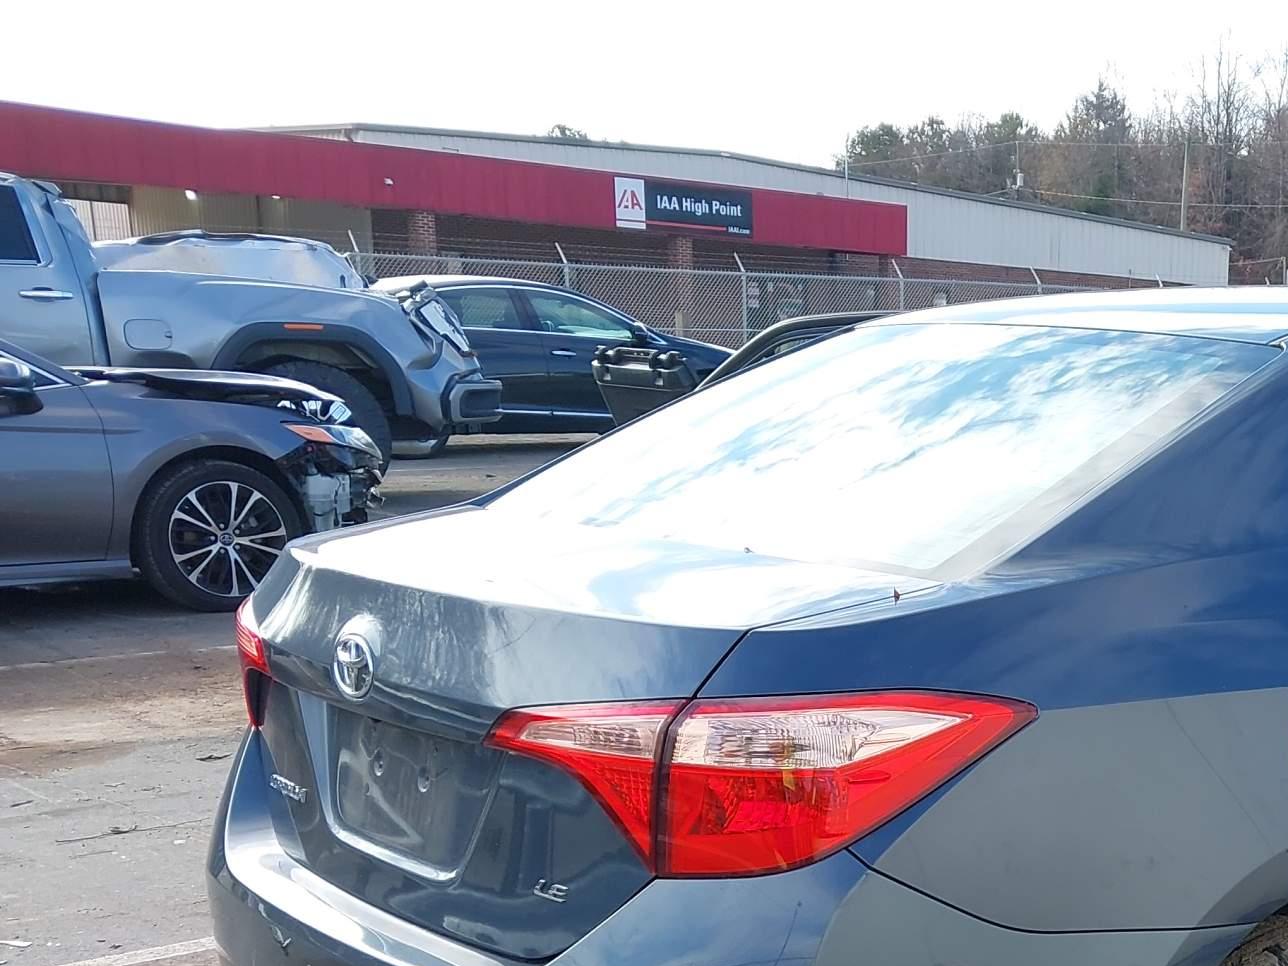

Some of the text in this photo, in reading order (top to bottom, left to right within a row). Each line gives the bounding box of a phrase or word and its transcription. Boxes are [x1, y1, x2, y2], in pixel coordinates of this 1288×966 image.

[656, 194, 742, 217] IAA High Point
[533, 879, 569, 903] LE
